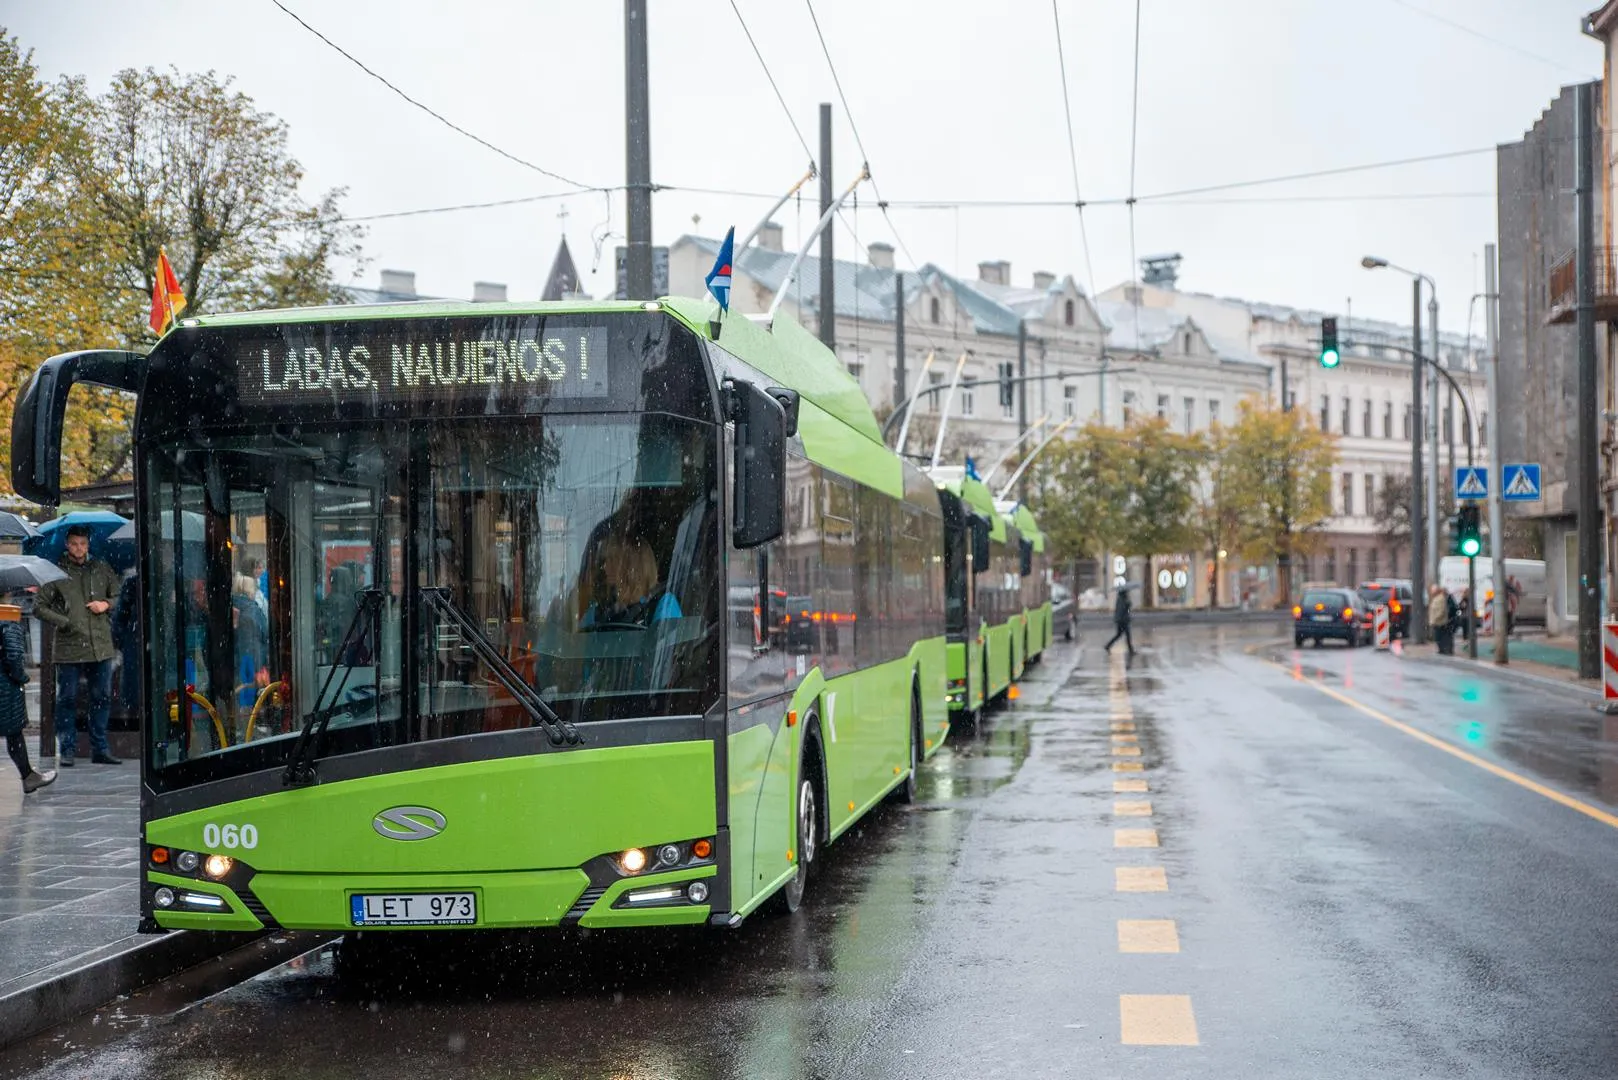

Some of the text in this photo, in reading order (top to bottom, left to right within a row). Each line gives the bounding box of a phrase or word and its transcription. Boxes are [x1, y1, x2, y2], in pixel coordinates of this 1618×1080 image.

[262, 336, 588, 392] LABAS, NAUJIENOS !
[203, 823, 259, 849] 060
[366, 896, 471, 919] LET 973
